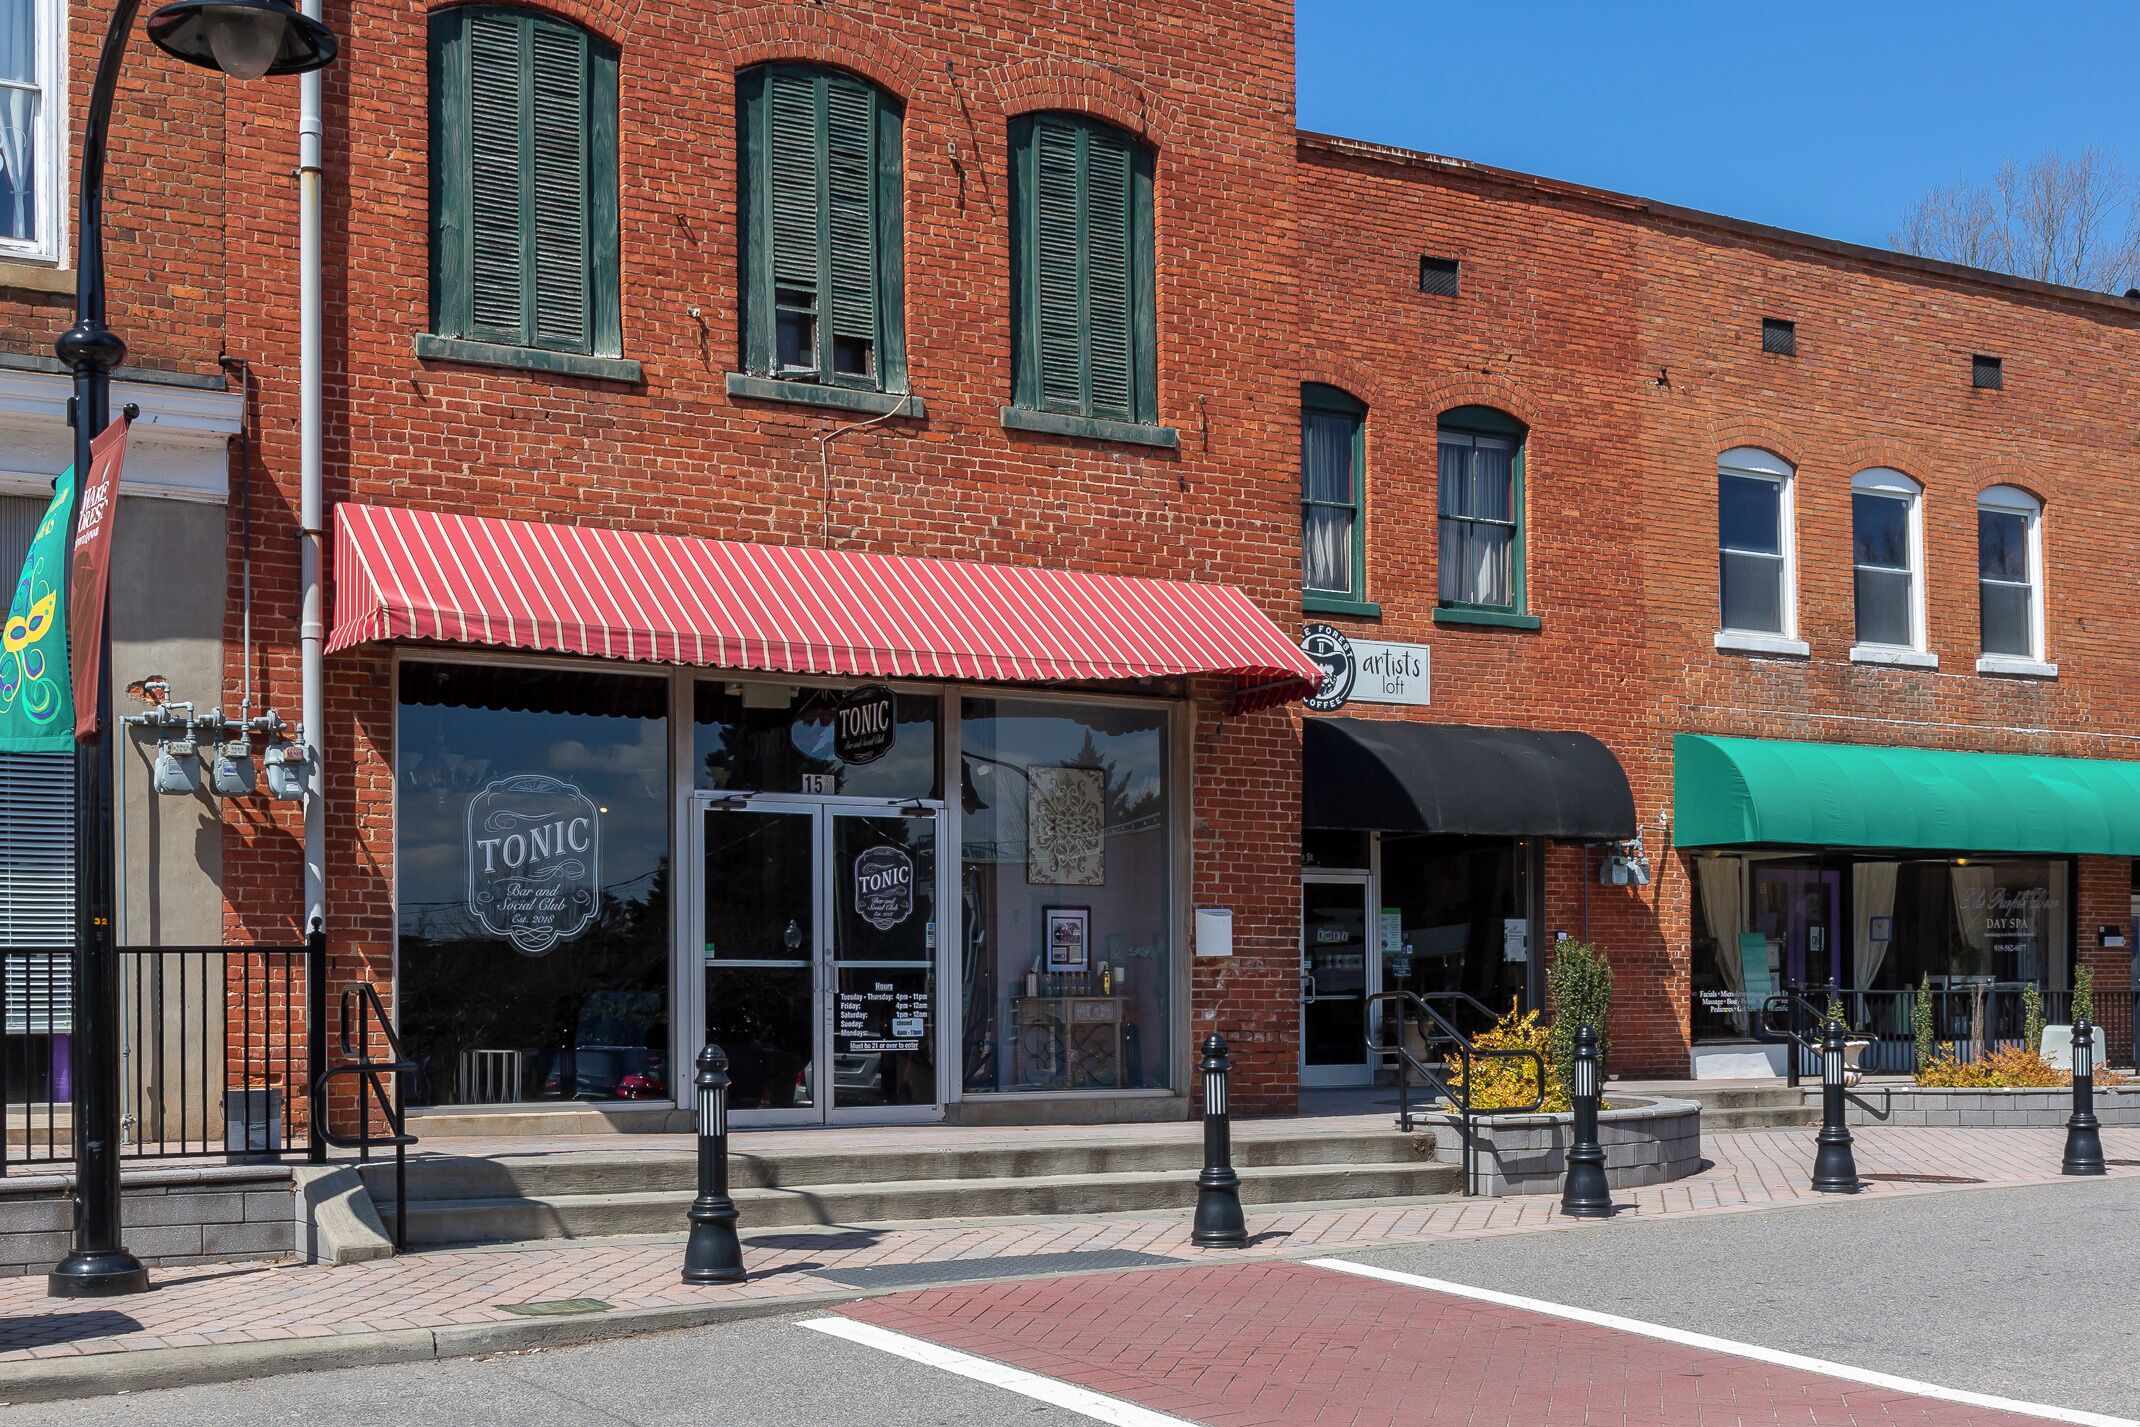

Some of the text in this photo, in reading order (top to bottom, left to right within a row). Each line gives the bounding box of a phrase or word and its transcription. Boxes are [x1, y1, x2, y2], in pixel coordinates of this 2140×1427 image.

[1382, 675, 1404, 695] loft
[839, 700, 889, 738] TONIC
[477, 817, 590, 874] TONIC
[859, 866, 909, 893] TONIC
[507, 883, 560, 897] Bar and
[497, 897, 567, 911] Social Club
[94, 917, 108, 925] 32
[511, 914, 555, 923] Est. 2018
[1987, 918, 2028, 929] DAY SPA
[875, 982, 893, 990] Hours
[840, 993, 863, 1001] Tuesday
[867, 993, 894, 1001] Thursday:
[895, 993, 908, 1001] 4pm
[913, 993, 927, 1001] 11pm
[1700, 990, 1718, 998] Facials
[840, 1002, 861, 1010] Friday:
[895, 1002, 908, 1010] 4pm
[840, 1011, 868, 1019] Saturday:
[895, 1011, 908, 1019] 1pm
[840, 1020, 864, 1028] Sunday:
